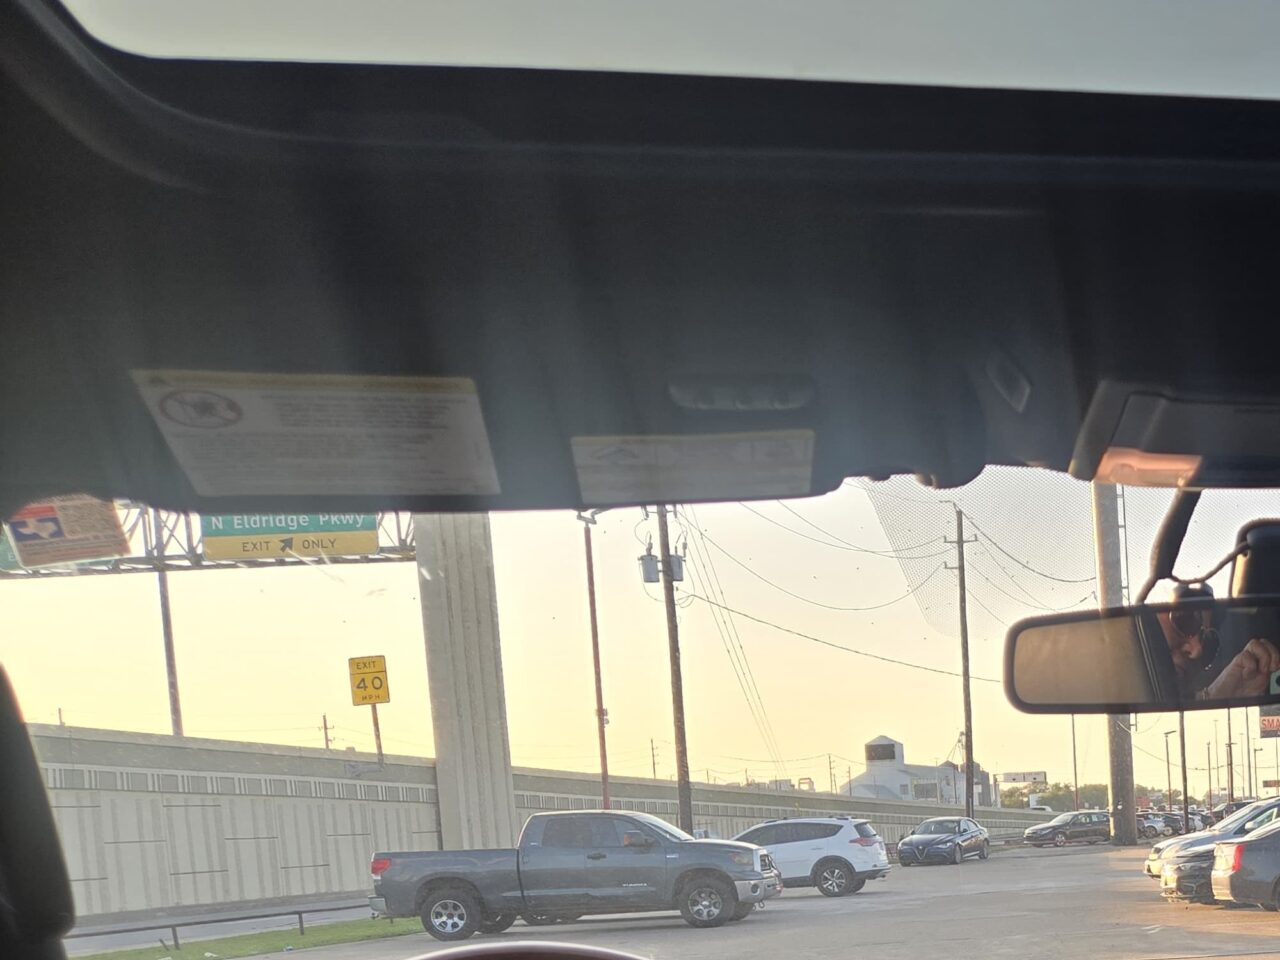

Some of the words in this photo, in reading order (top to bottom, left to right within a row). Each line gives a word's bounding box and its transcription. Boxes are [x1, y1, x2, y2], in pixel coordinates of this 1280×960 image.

[211, 516, 223, 530] N
[233, 514, 310, 530] Eldridge
[319, 514, 364, 527] Pkwy
[242, 540, 272, 552] EXIT
[302, 538, 337, 549] ONLY
[356, 661, 376, 670] EXIT
[356, 676, 383, 691] 40
